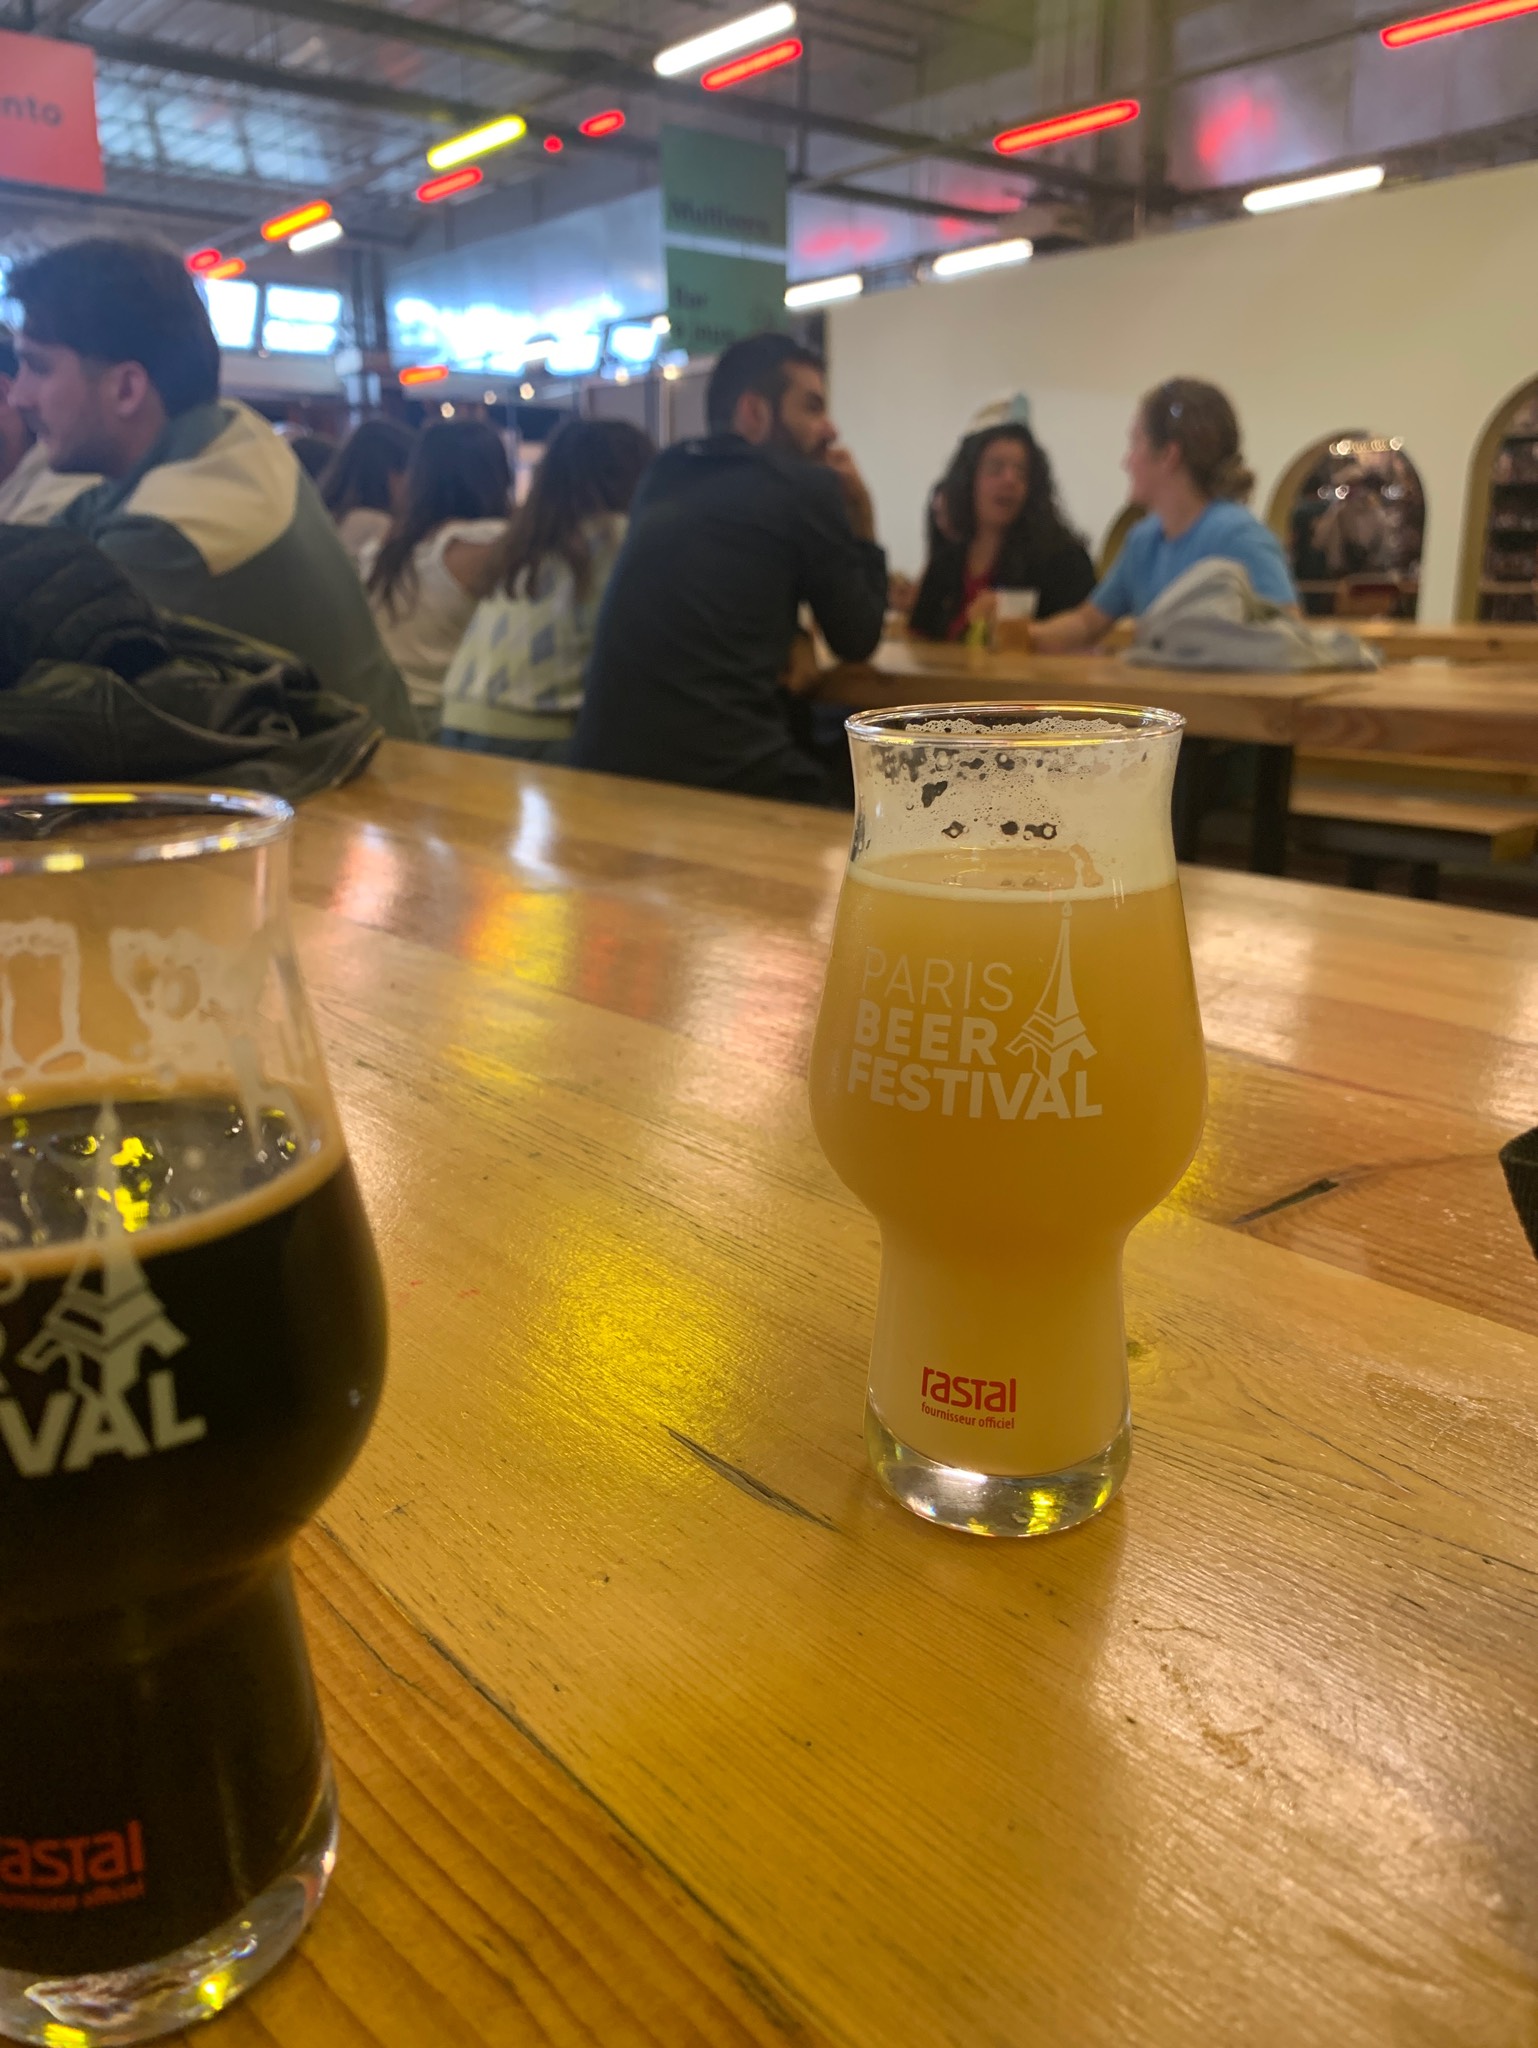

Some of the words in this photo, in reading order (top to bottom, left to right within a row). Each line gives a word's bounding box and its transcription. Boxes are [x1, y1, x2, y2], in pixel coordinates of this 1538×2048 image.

[863, 947, 1013, 1012] PARIS
[854, 998, 998, 1065] BEER
[848, 1049, 1103, 1120] FESTIVAL
[921, 1366, 1017, 1413] rastal
[921, 1402, 976, 1427] fournisseur
[978, 1416, 1015, 1430] officiel
